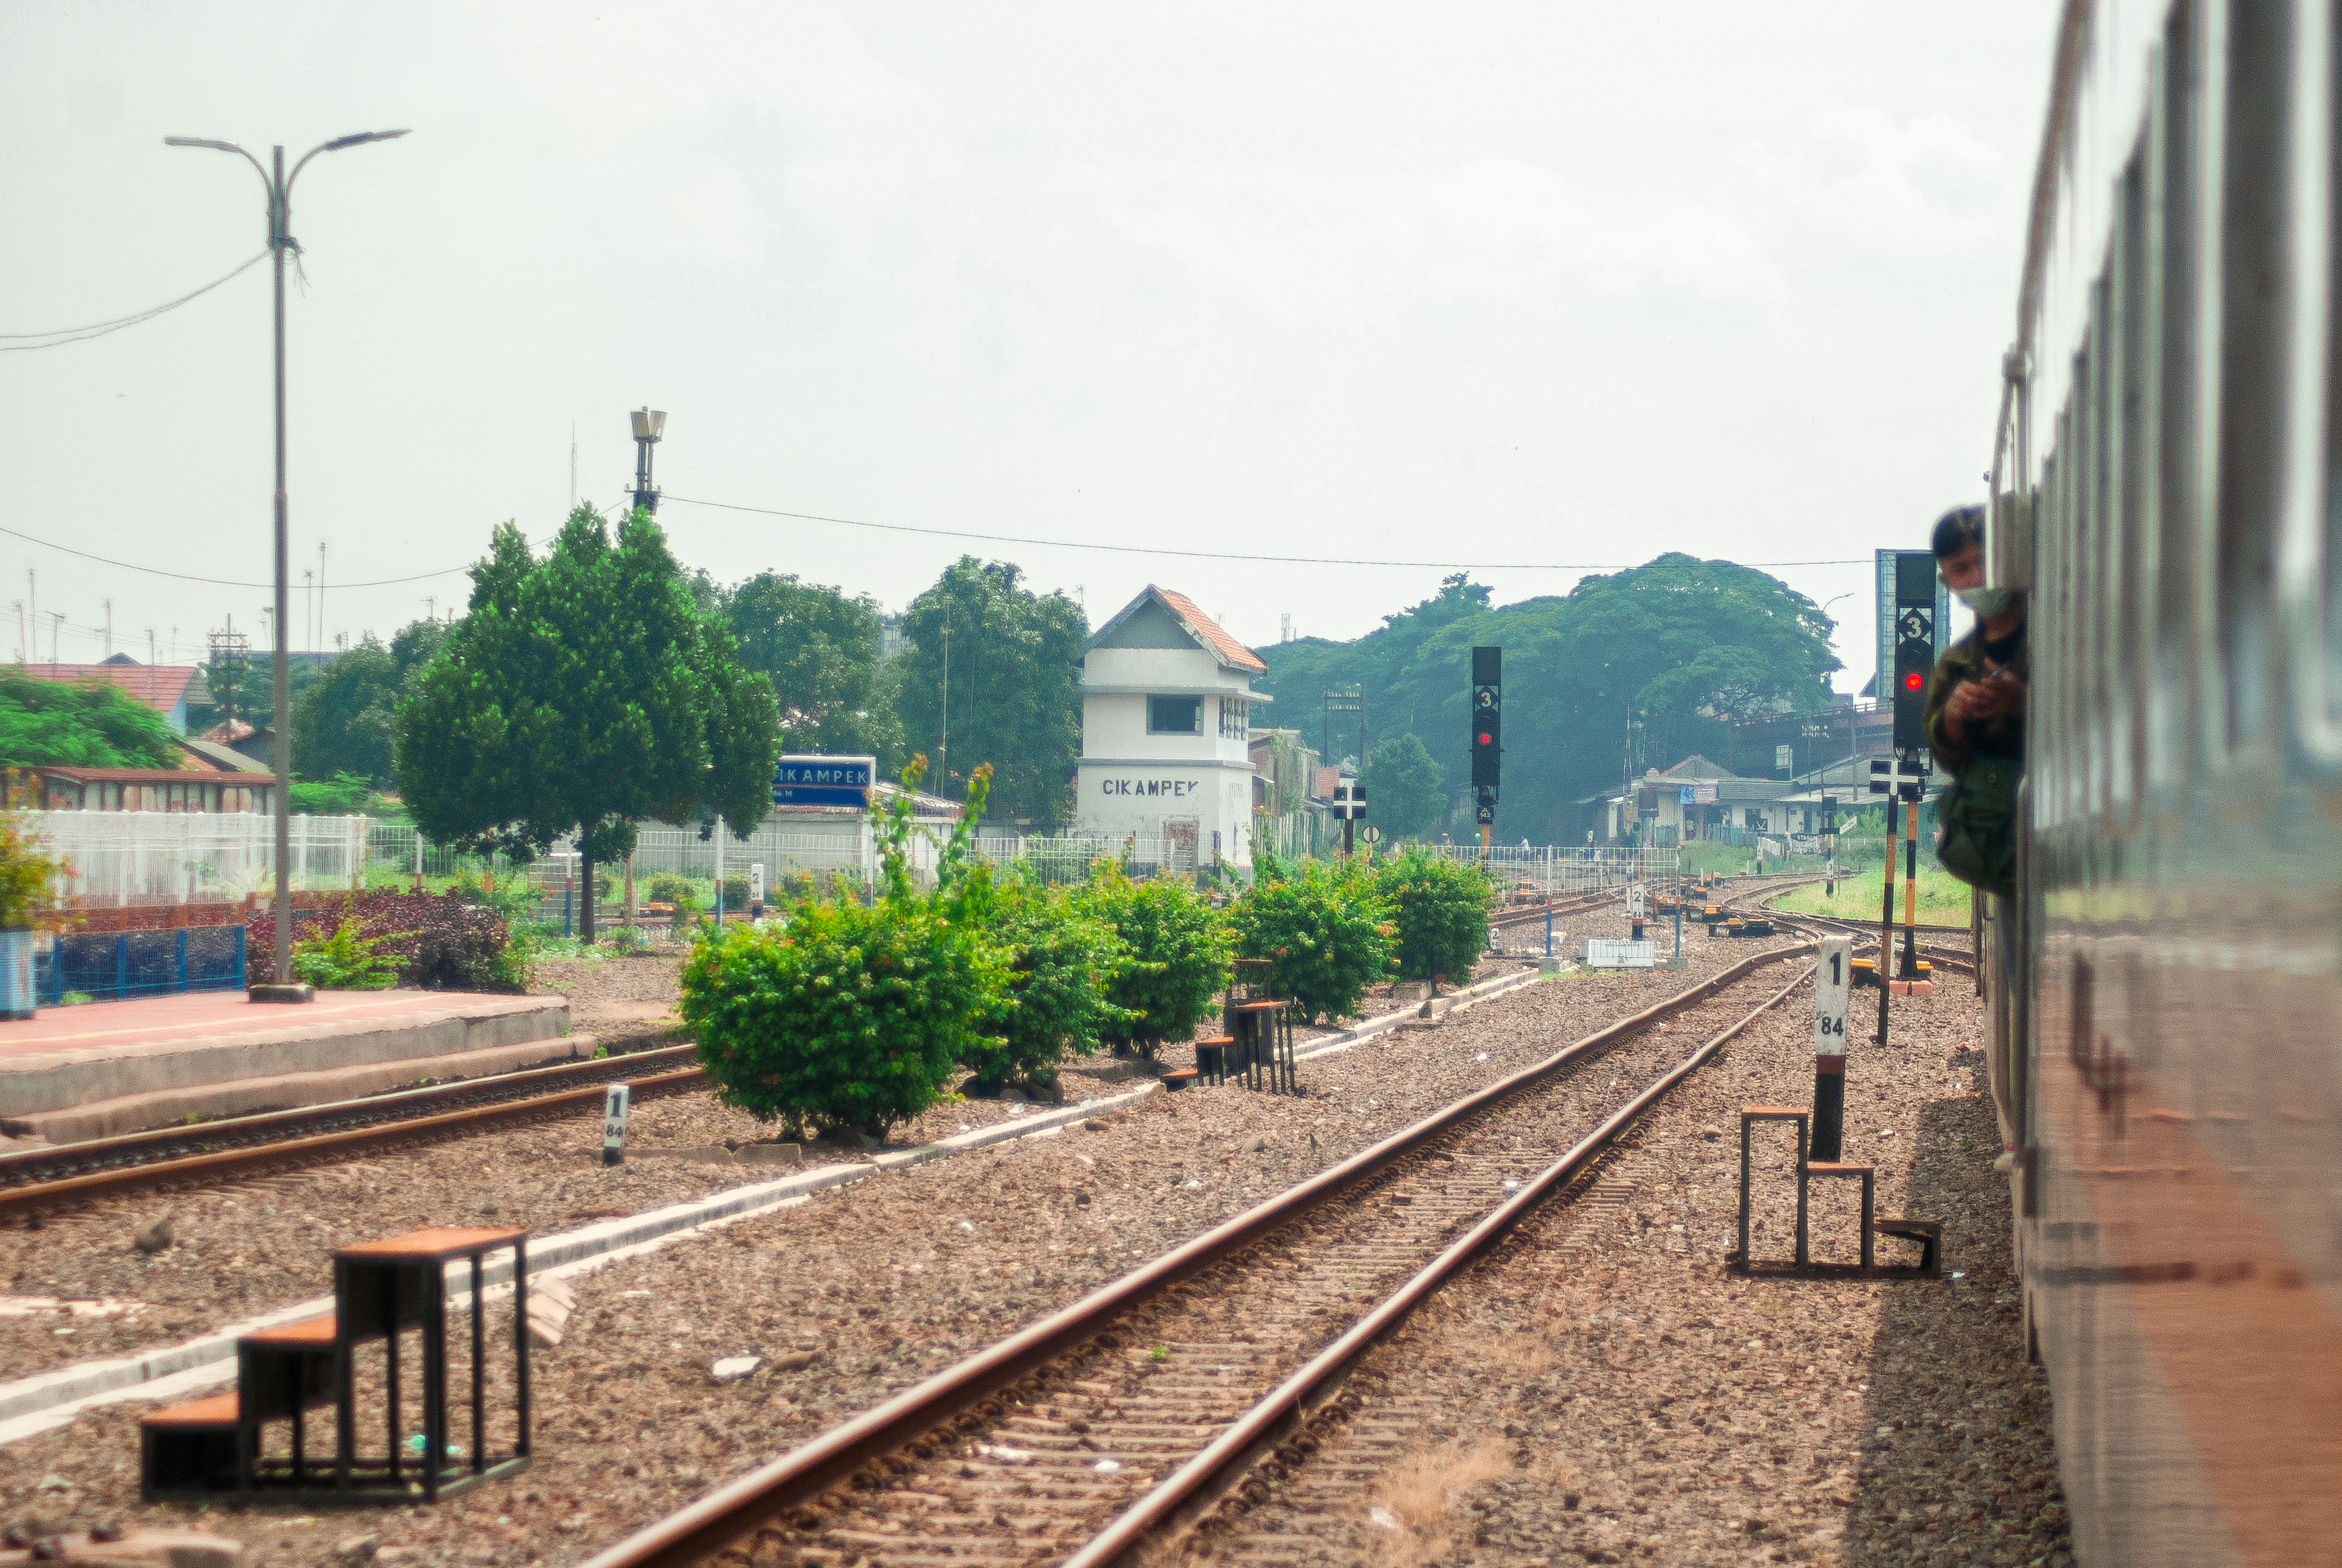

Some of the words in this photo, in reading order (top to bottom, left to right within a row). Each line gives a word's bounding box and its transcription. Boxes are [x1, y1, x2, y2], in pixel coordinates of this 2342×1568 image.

[1907, 617, 1921, 638] 3
[1481, 692, 1491, 707] 3
[772, 768, 867, 784] IKAMPEK
[752, 873, 760, 884] 2
[1634, 891, 1641, 902] 2
[1492, 931, 1499, 939] 2
[1830, 952, 1840, 985] 1
[1821, 1016, 1844, 1036] 84
[611, 1091, 621, 1117] 1
[606, 1124, 622, 1137] 84
